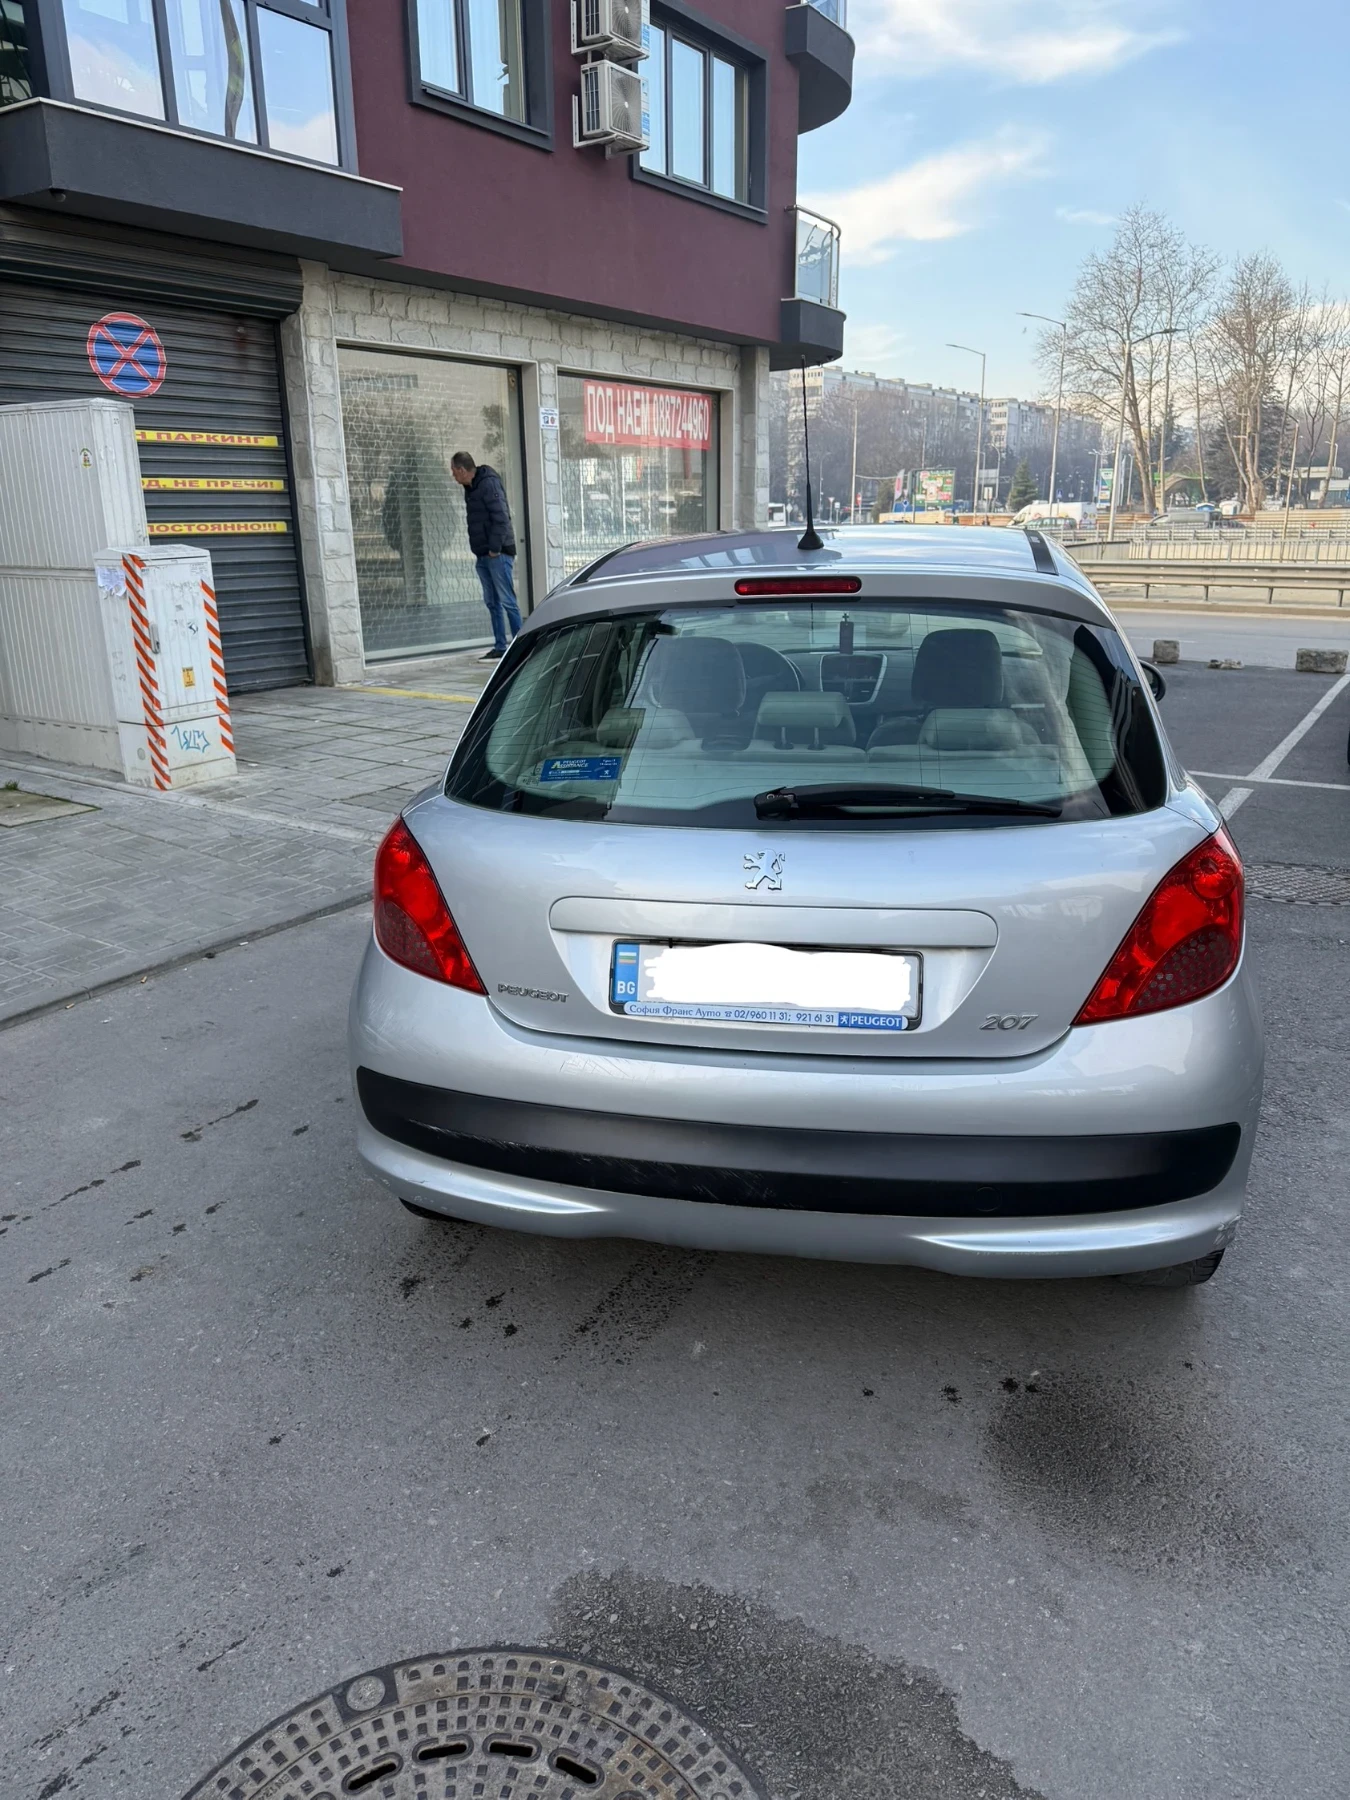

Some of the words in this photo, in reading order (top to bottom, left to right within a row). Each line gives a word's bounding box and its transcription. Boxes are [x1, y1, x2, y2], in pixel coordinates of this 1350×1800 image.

[587, 385, 615, 443] ПОД
[617, 388, 650, 436] НАЕМ
[652, 393, 710, 441] 0887244960
[156, 432, 265, 444] ПАРКИНГ
[174, 480, 200, 489] НЕ
[206, 479, 274, 489] ПРЕЧИ!
[497, 983, 570, 1003] PEUGEOT
[617, 980, 636, 995] BG
[629, 1004, 661, 1015] София
[662, 1005, 693, 1018] Франс
[695, 1007, 721, 1017] Ауто
[734, 1009, 767, 1020] 02/960
[769, 1011, 776, 1020] 11
[796, 1013, 812, 1022] 921
[825, 1014, 834, 1023] 31
[850, 1015, 902, 1027] PEUGEOT
[979, 1013, 1039, 1030] 207
